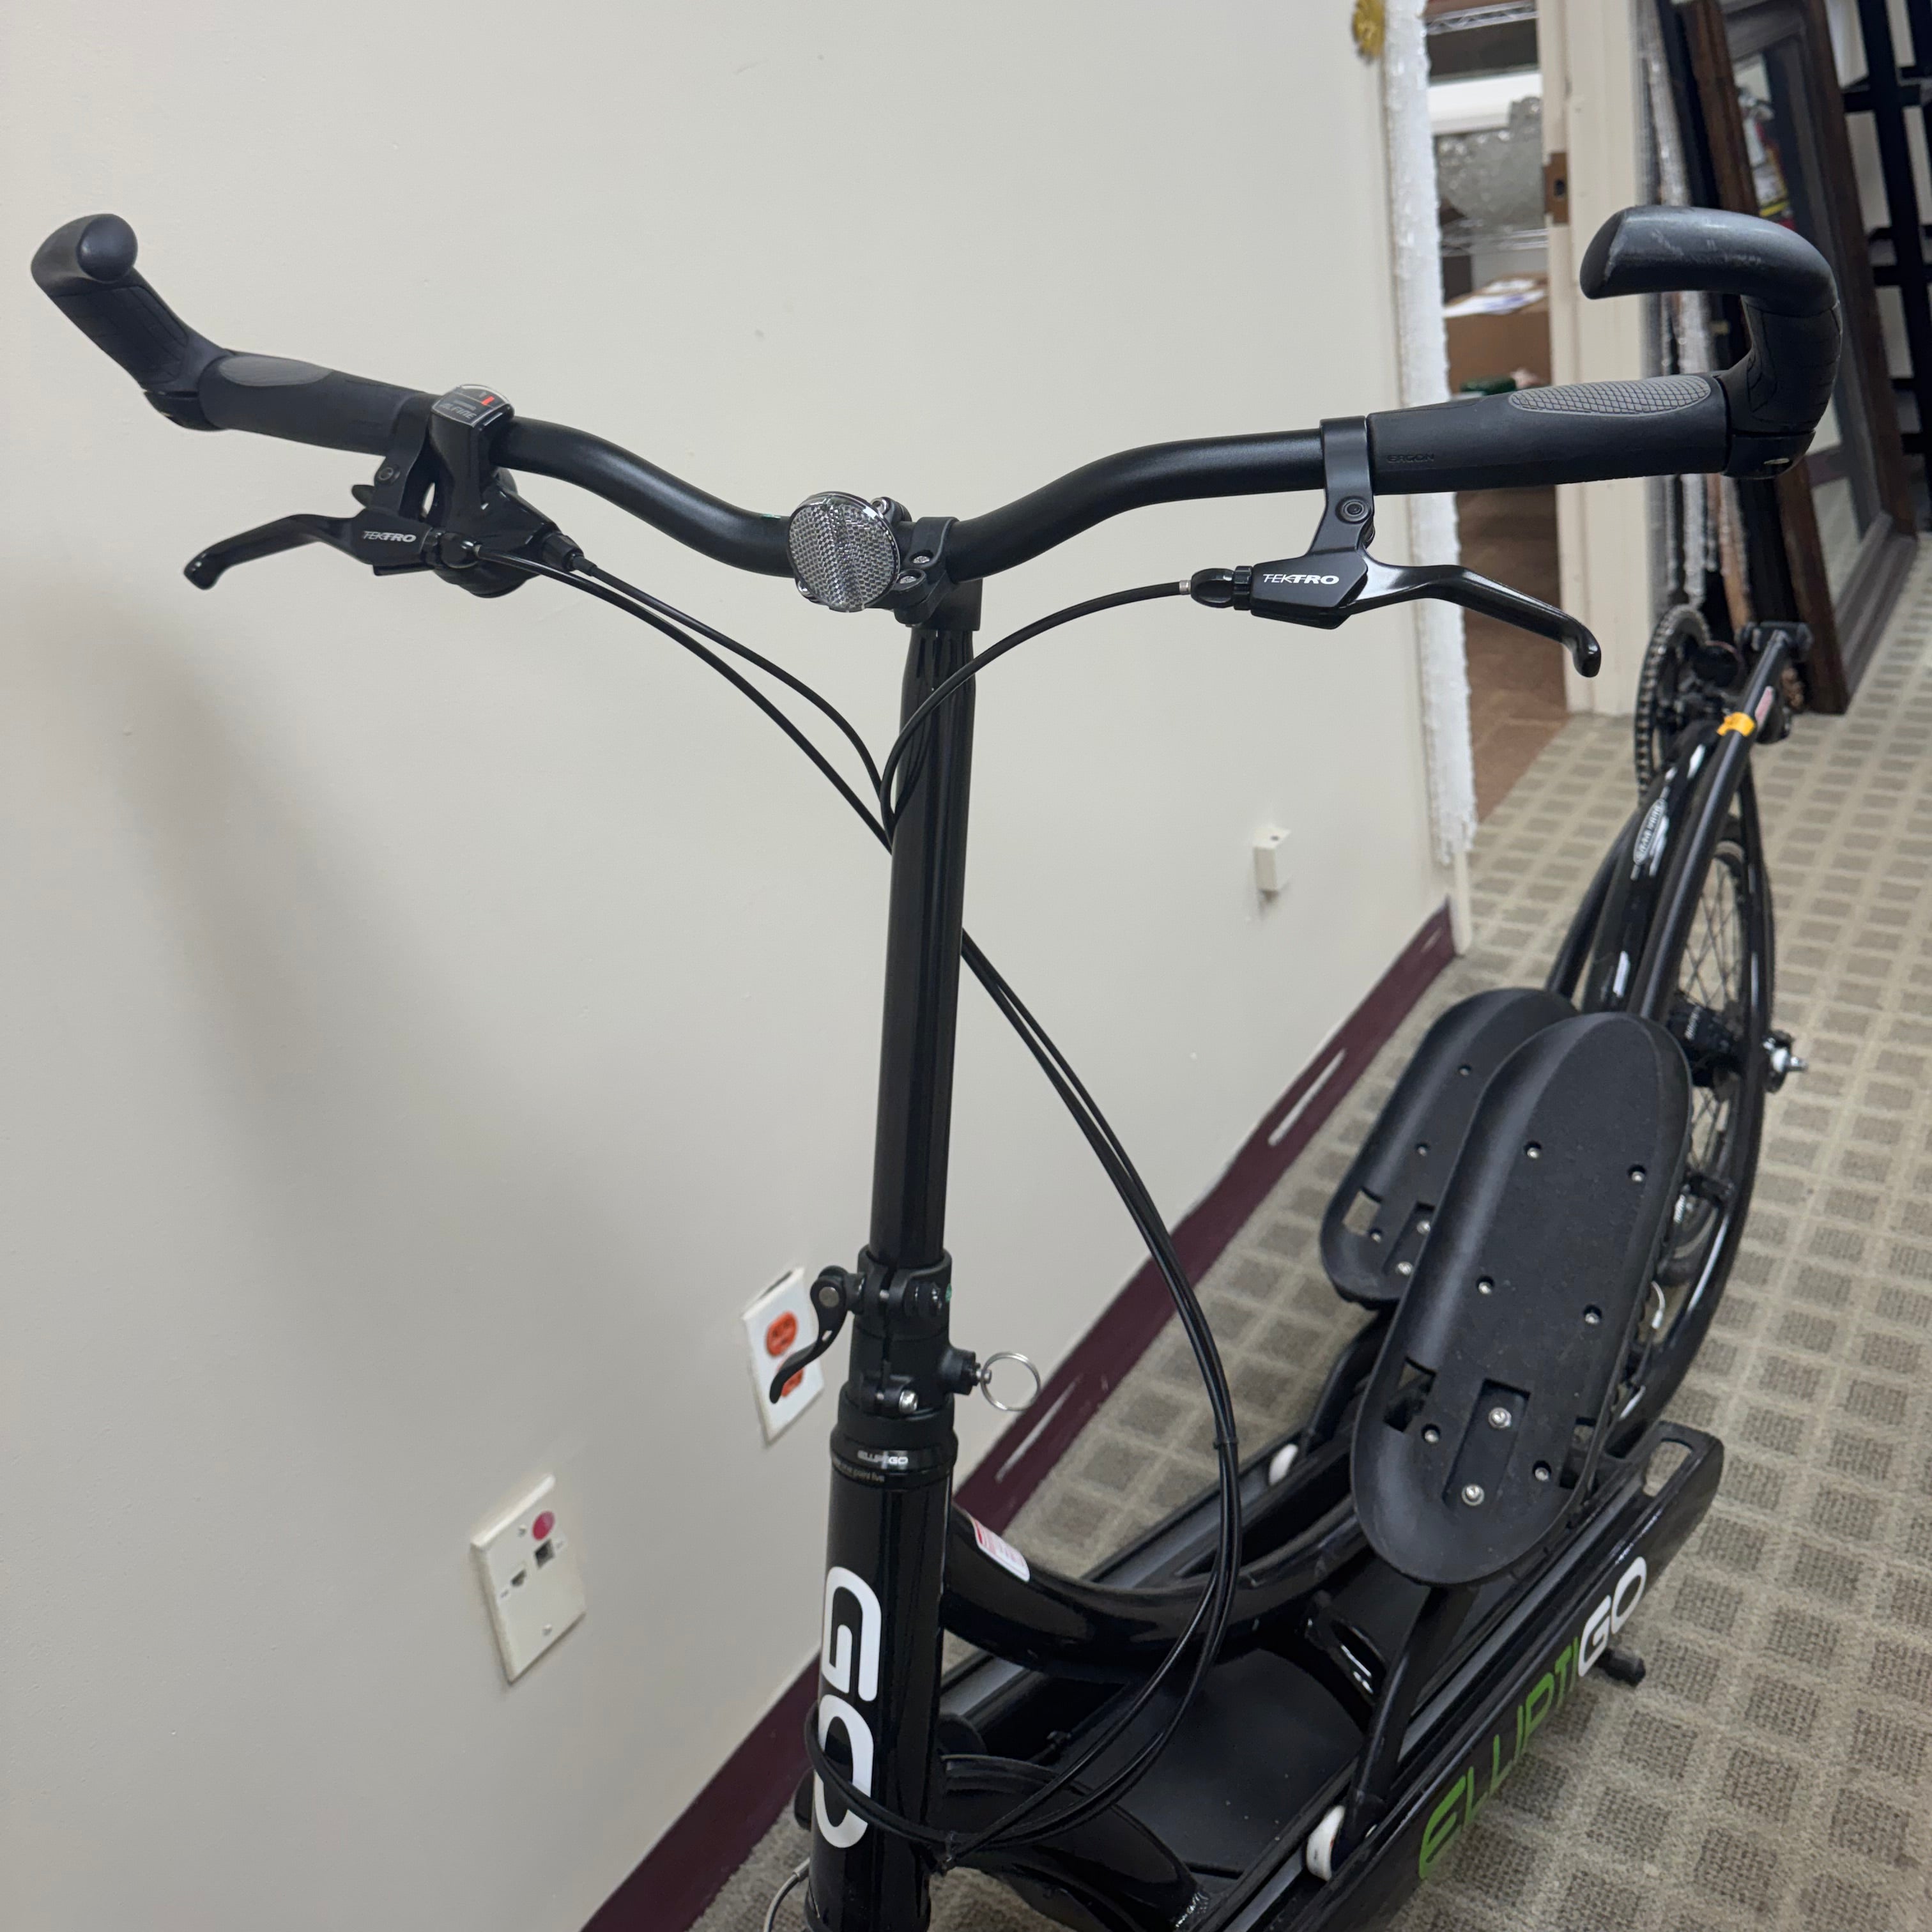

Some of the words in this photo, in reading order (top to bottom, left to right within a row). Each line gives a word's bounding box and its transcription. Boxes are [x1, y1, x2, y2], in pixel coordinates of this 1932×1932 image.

[362, 530, 417, 542] TEKTRO
[1262, 574, 1340, 585] TEKTRO
[814, 1566, 882, 1848] GO
[1419, 1556, 1647, 1879] ELLIPTIGO
